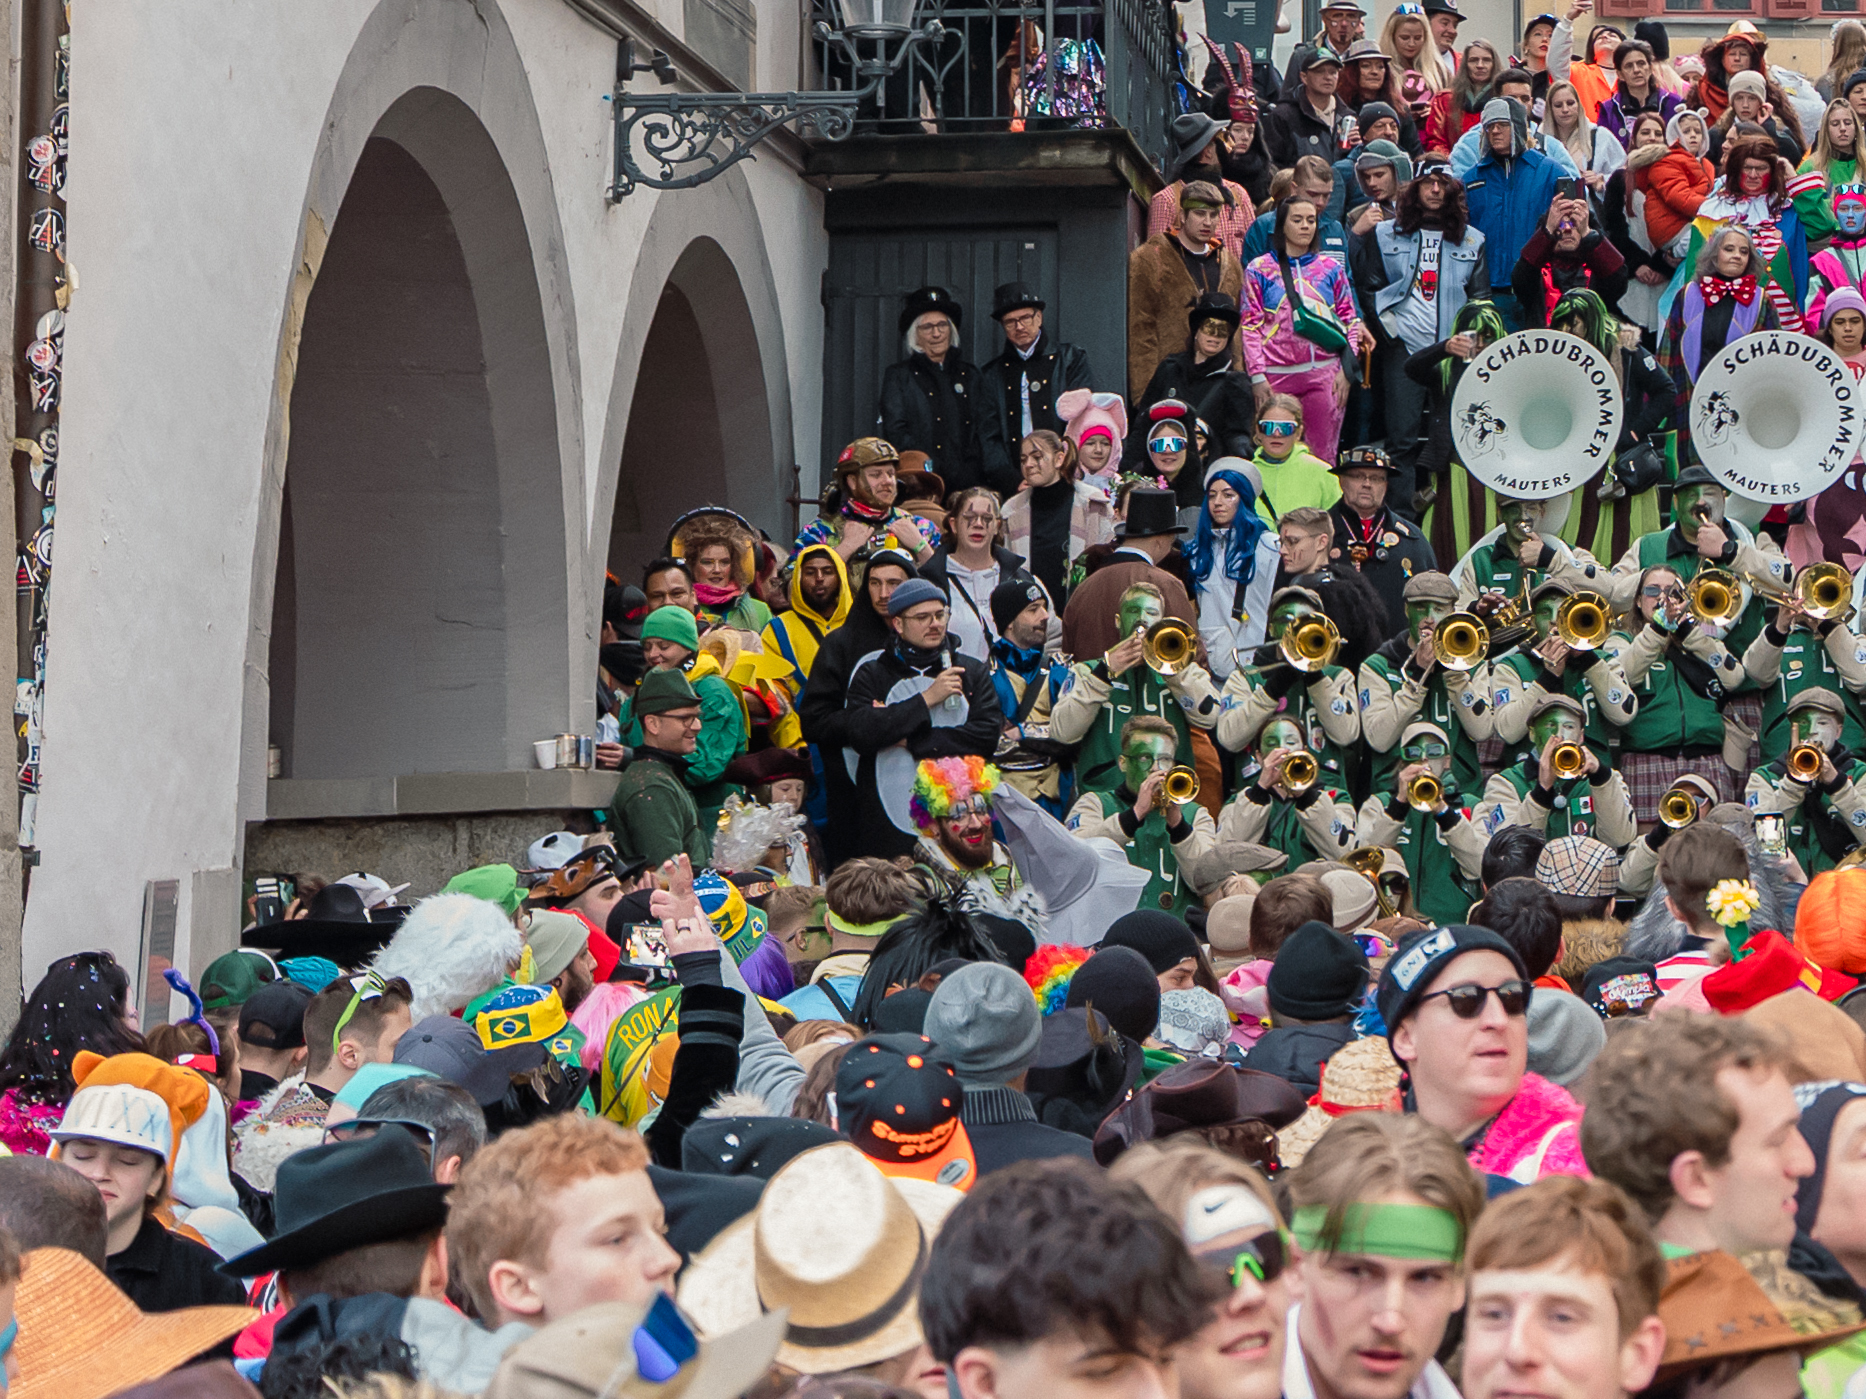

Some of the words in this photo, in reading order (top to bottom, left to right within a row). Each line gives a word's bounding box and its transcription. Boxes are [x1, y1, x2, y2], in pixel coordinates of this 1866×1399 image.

[1476, 333, 1614, 459] SCHÄDUBROMMER
[1723, 333, 1855, 474] SCHÄDUBROMMER
[1493, 472, 1572, 491] MAUTERS
[1723, 468, 1801, 496] MAUTERS
